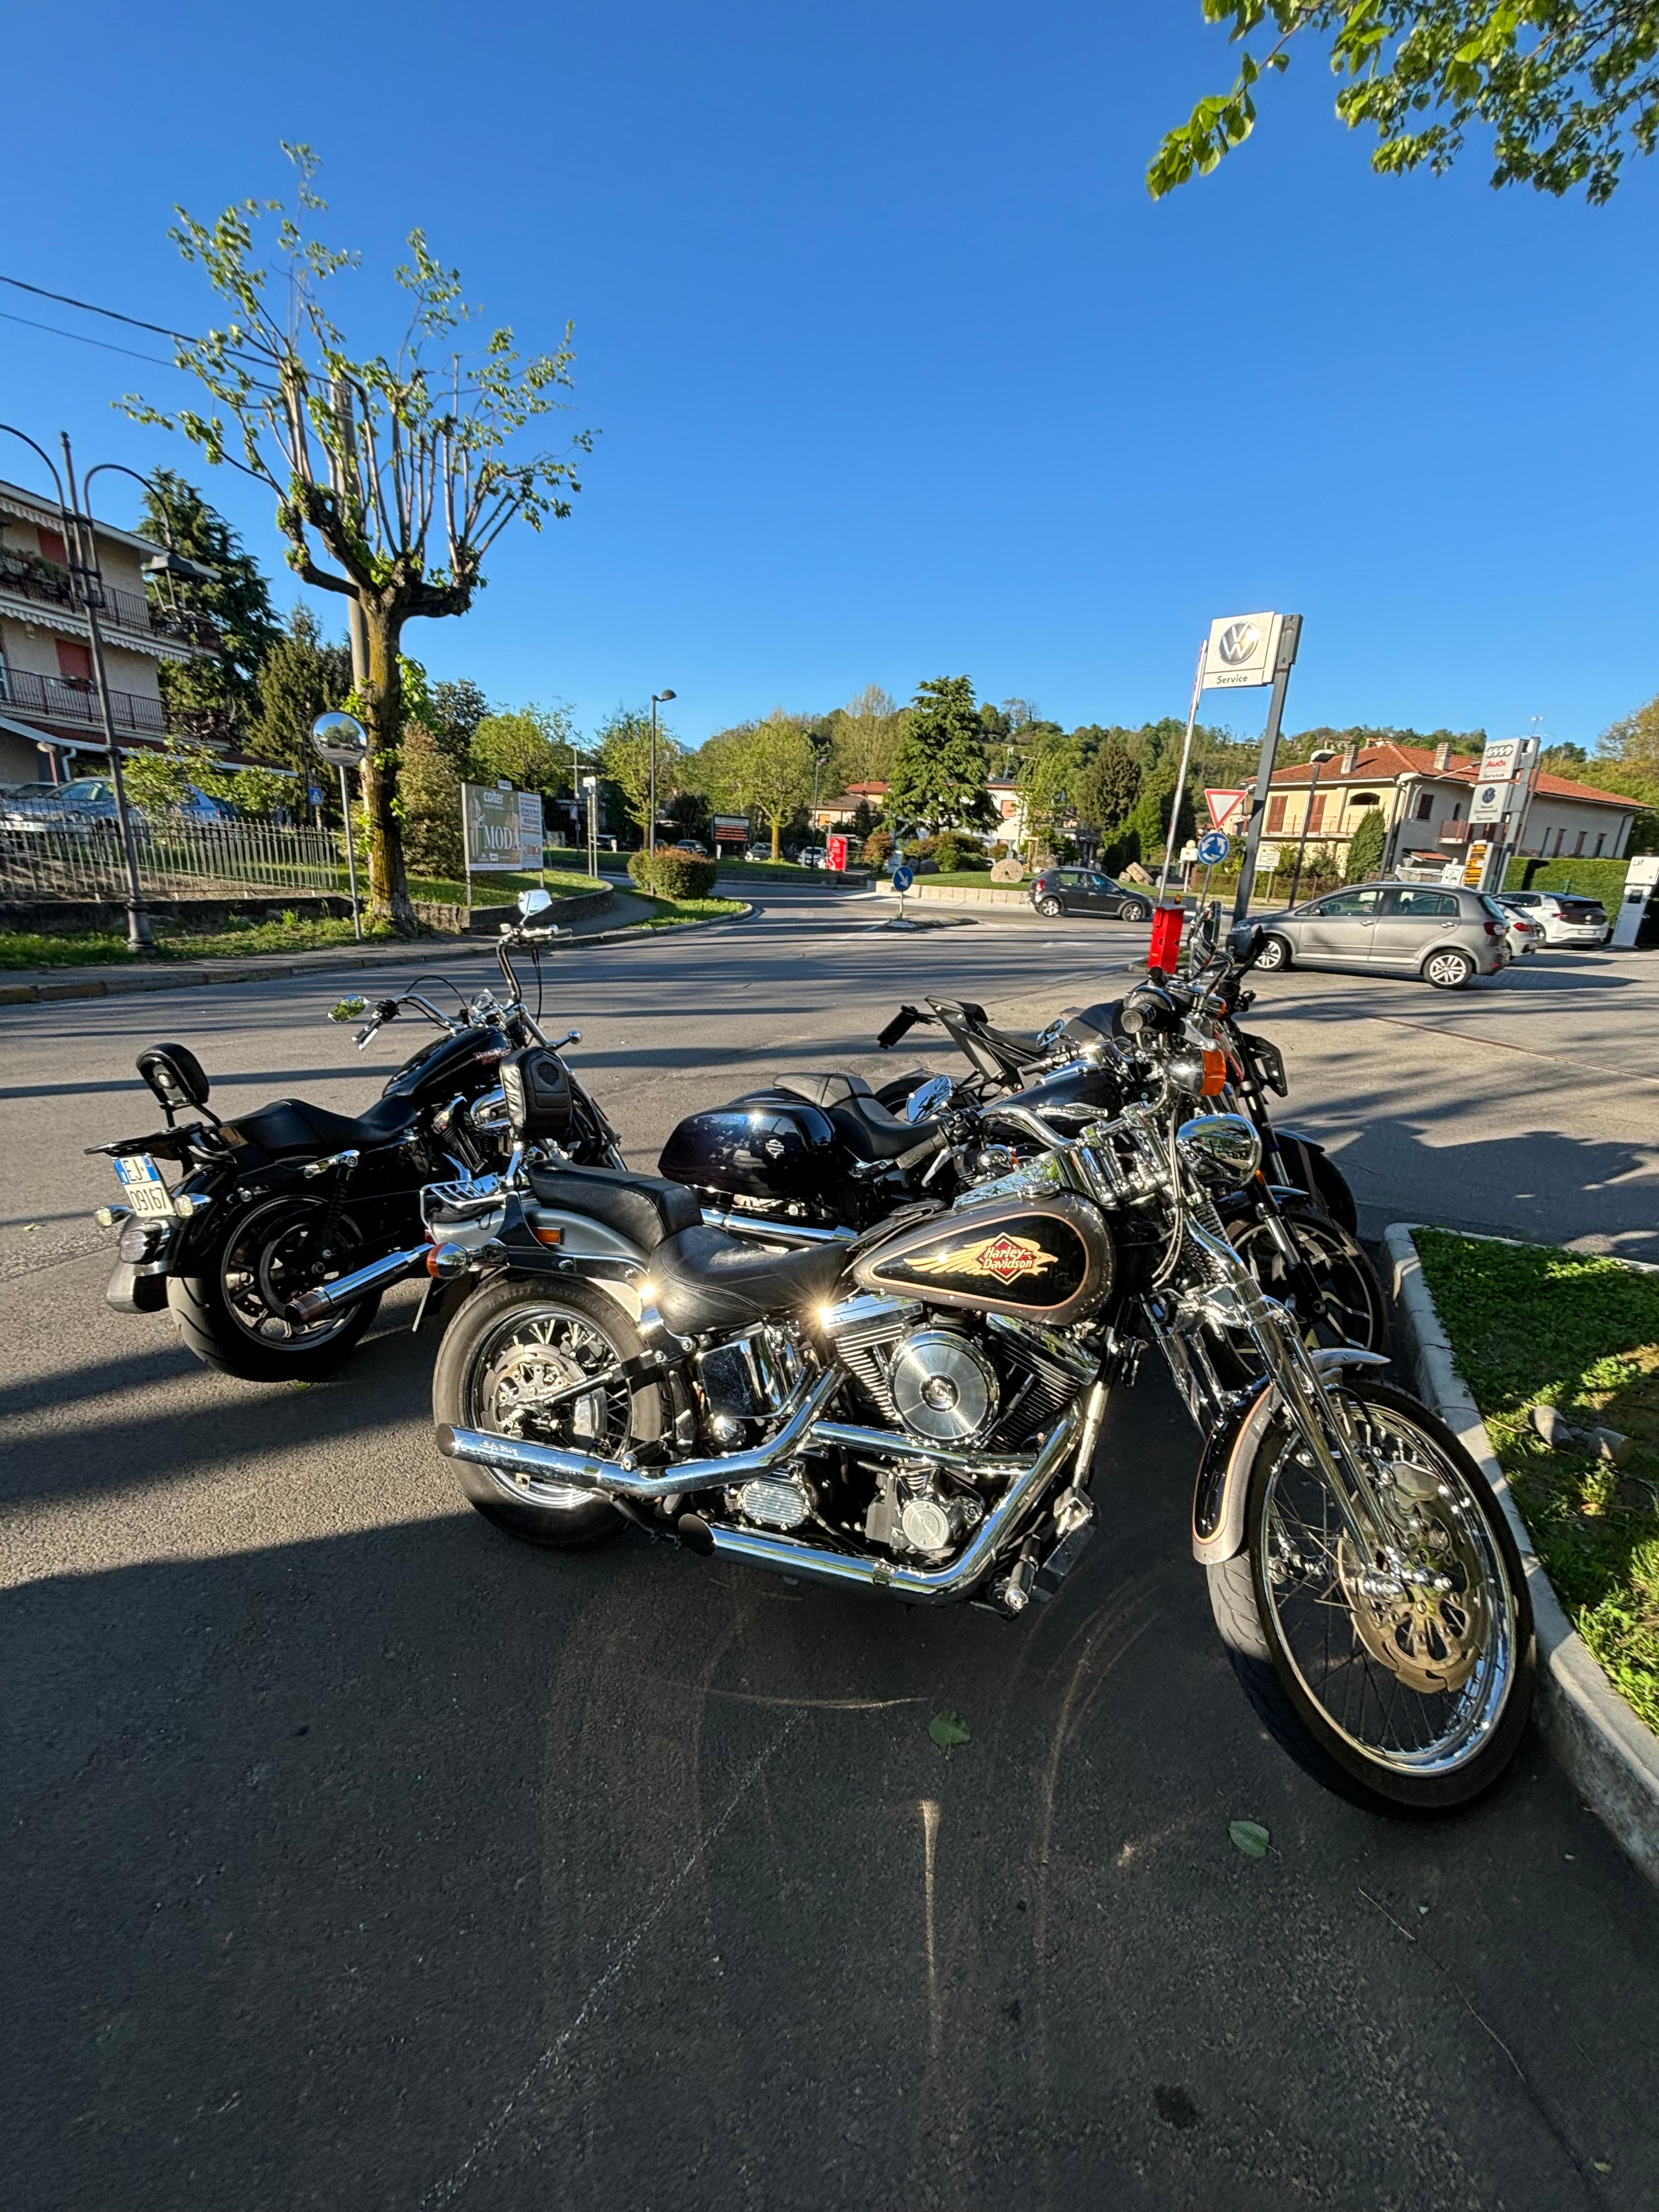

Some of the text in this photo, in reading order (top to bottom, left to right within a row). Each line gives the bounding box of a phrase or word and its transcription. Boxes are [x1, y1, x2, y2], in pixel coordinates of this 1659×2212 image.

[1217, 674, 1248, 684] Service
[1486, 759, 1506, 768] Audi
[484, 825, 520, 849] MODA
[123, 1158, 143, 1182] EJ
[130, 1187, 167, 1211] 09167
[983, 1246, 1032, 1259] Harley-
[983, 1258, 1033, 1269] Davidson
